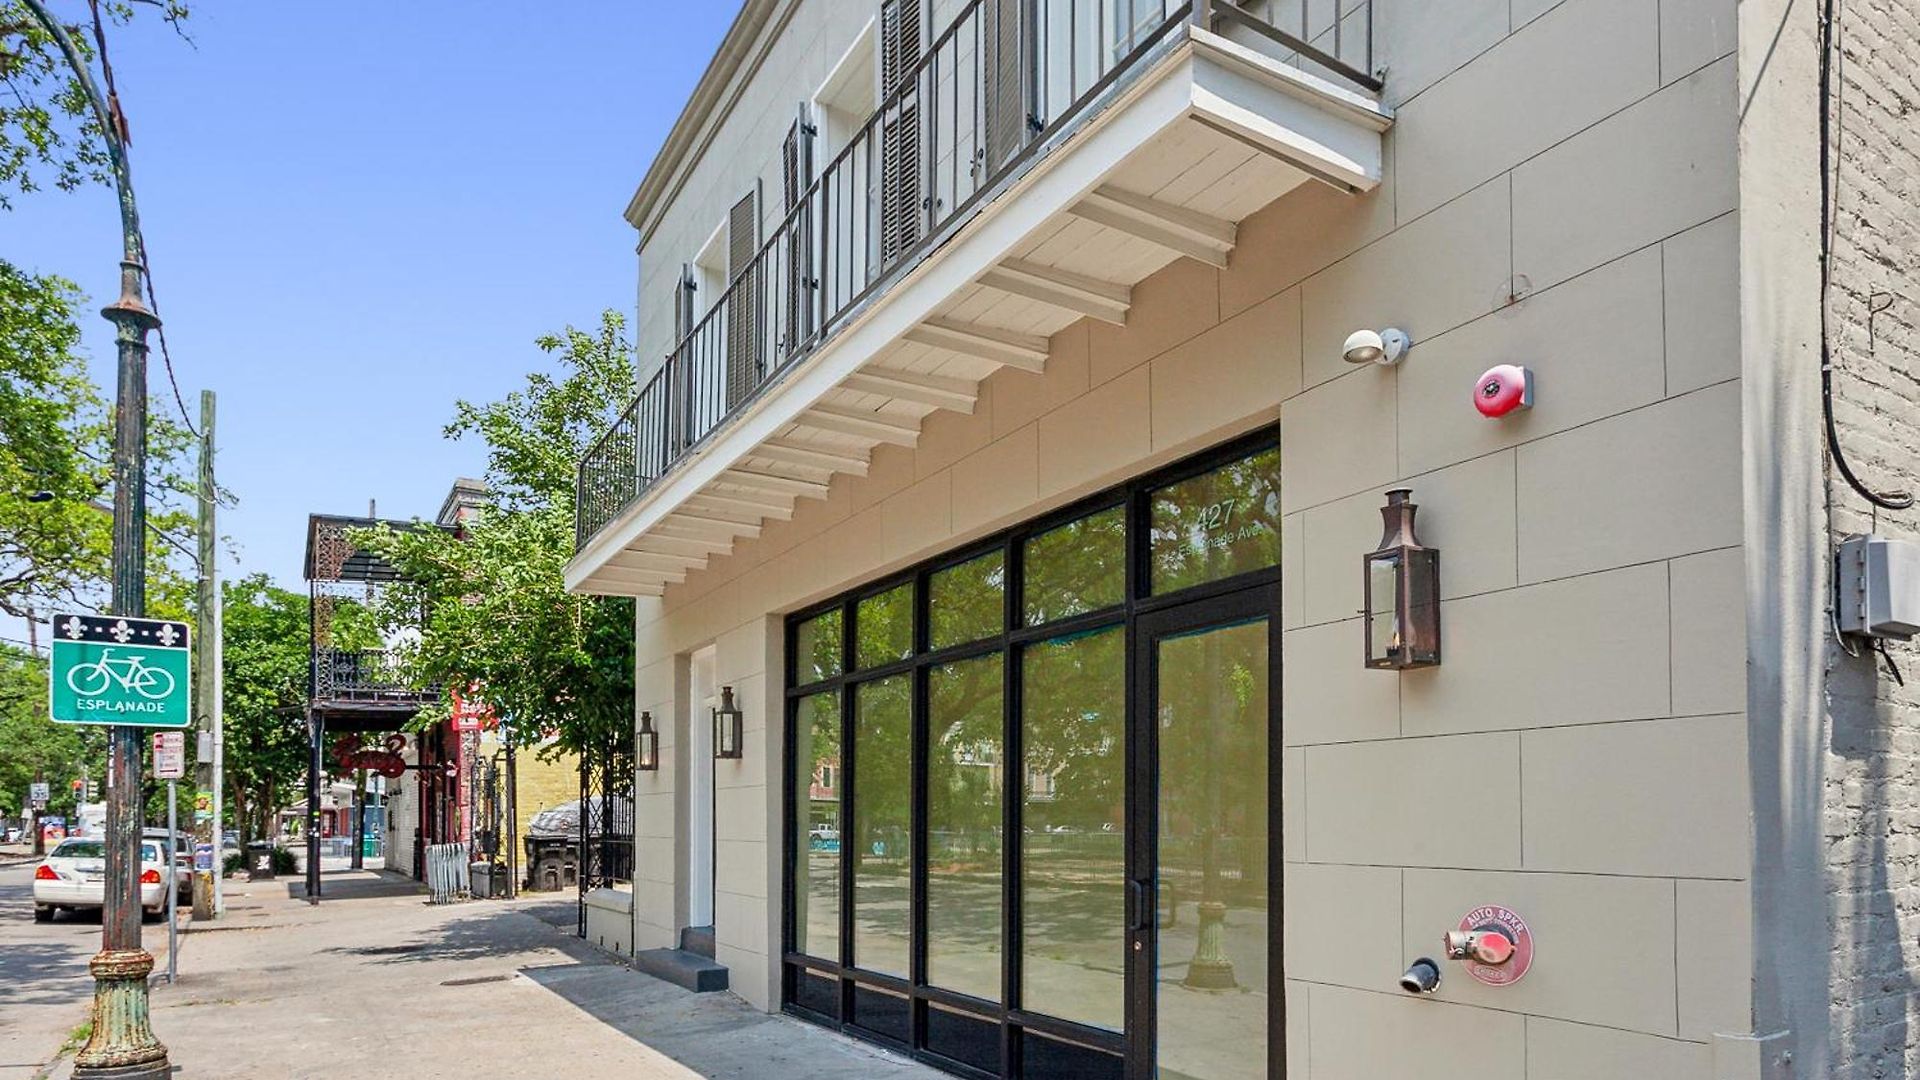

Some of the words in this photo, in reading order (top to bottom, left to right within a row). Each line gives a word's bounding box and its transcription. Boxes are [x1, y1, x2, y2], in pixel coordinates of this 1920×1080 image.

[1197, 499, 1236, 531] 427
[1179, 531, 1235, 554] Esanade
[76, 698, 166, 713] ESPLANADE
